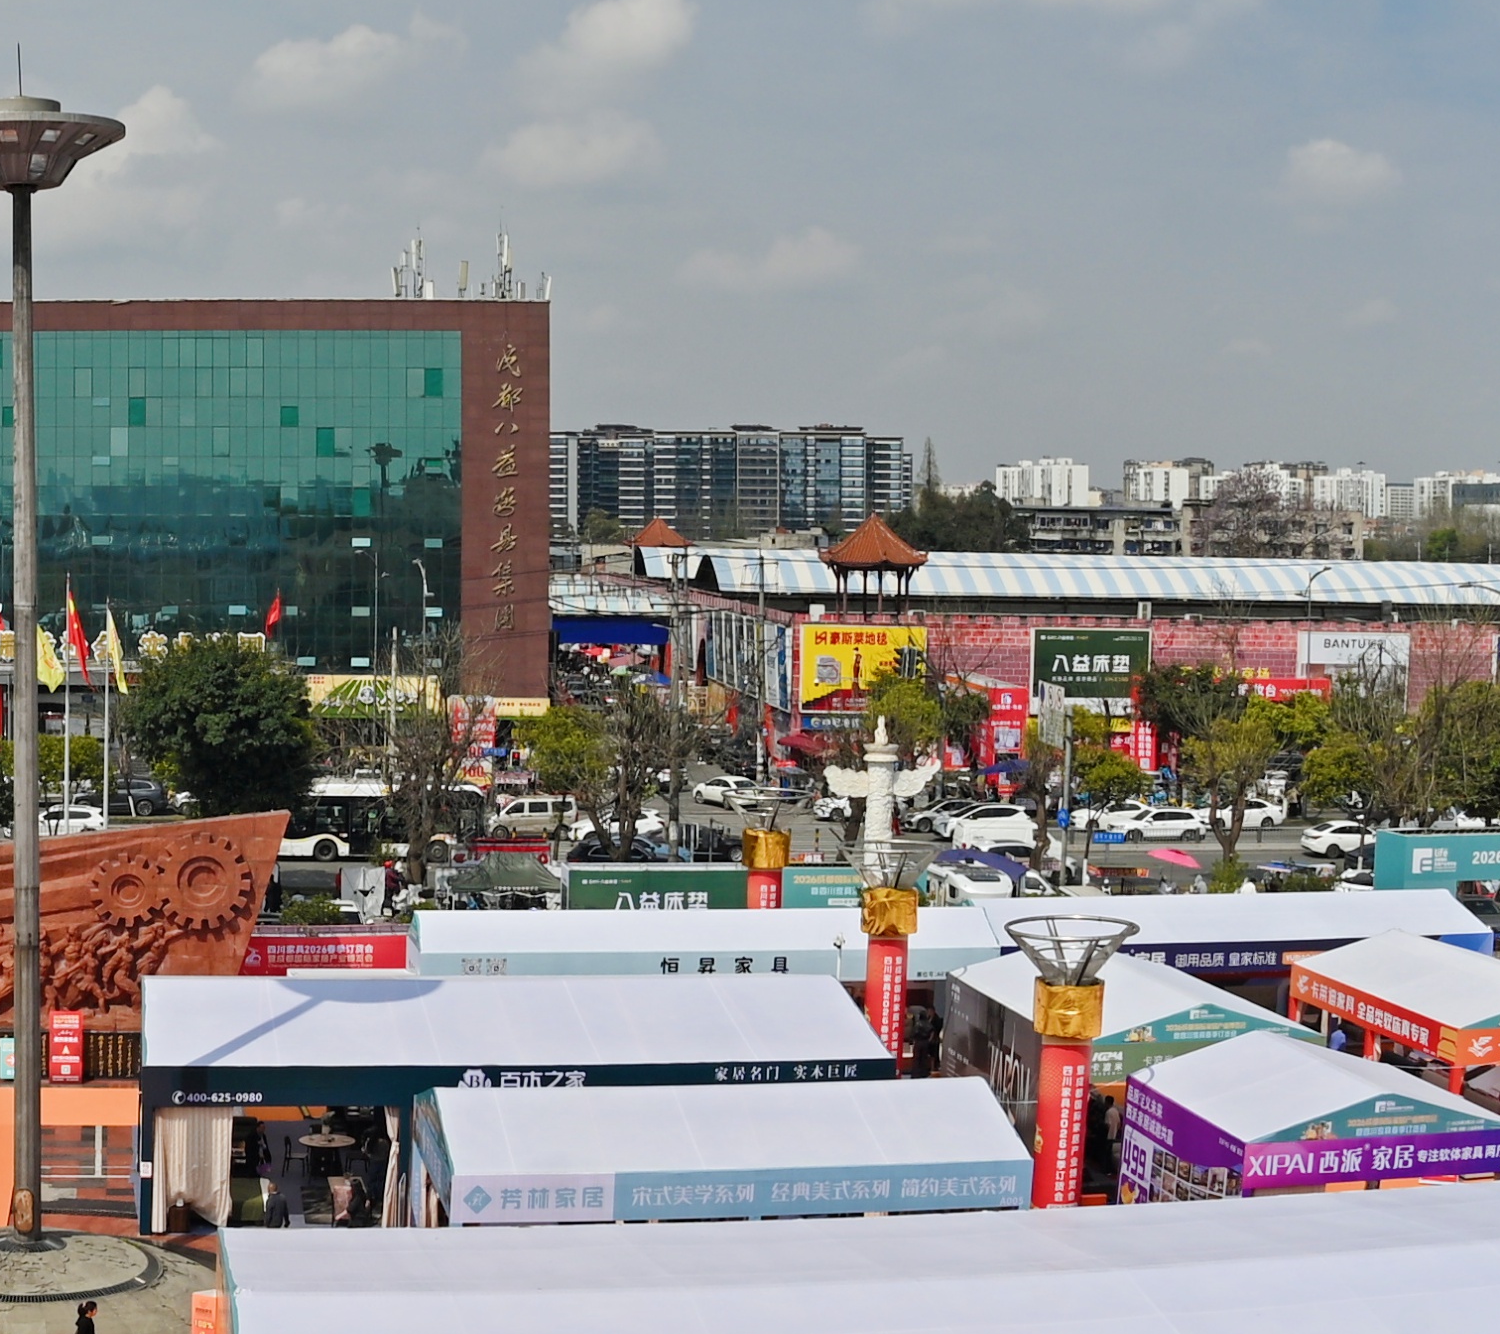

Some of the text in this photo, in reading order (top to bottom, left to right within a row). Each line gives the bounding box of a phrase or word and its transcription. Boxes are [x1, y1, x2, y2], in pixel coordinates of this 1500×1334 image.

[491, 342, 521, 631] 成都八益家具集团
[1324, 639, 1367, 649] BANTU
[1052, 655, 1130, 673] 八益床垫
[661, 956, 789, 975] 恒昇家具
[1174, 951, 1277, 968] 御用品质 皇家标准
[714, 1065, 781, 1082] 家居名门
[792, 1063, 857, 1080] 实木巨匠
[186, 1092, 263, 1103] 400-625-0980
[1246, 1152, 1315, 1178] XIPAI
[1416, 1144, 1484, 1164] 专注软体家具
[500, 1173, 1017, 1209] 芳林家居 宋式美学系列 经典美式系列 简约美式系列
